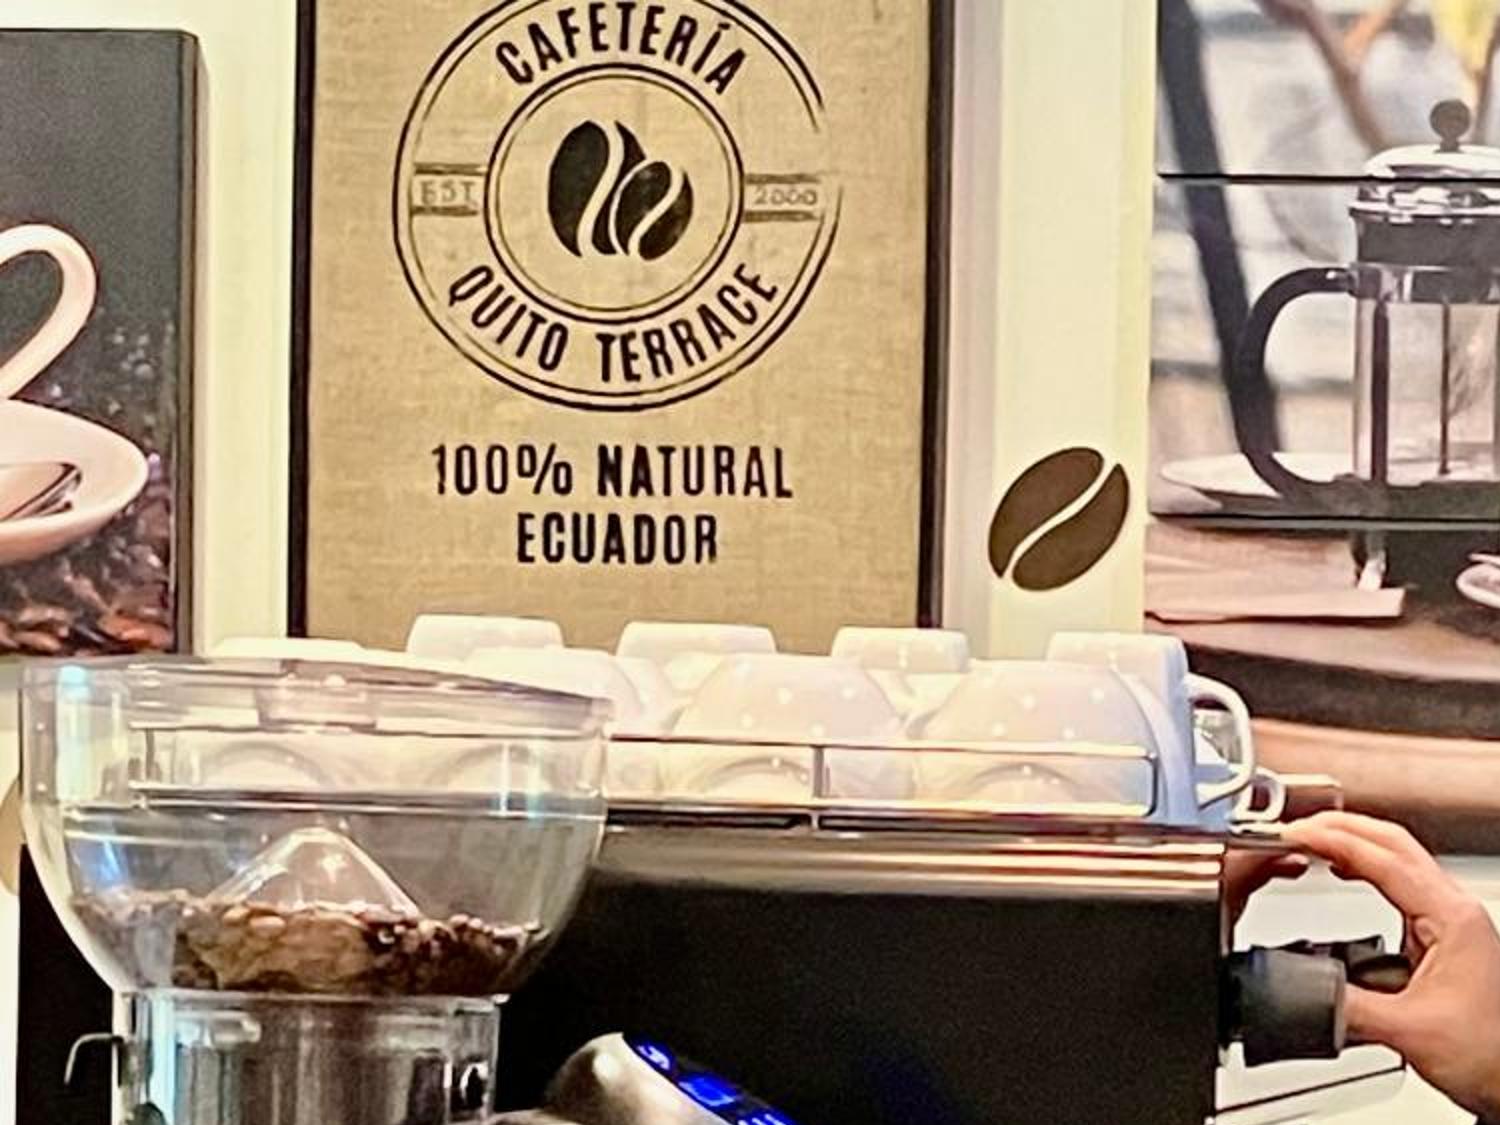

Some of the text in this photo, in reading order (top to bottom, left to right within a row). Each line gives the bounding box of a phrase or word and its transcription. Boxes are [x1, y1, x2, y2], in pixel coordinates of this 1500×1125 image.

[495, 2, 746, 95] CAFETERÍA
[448, 263, 778, 383] QUITO TERRACE
[431, 443, 793, 499] 100% NATURAL
[517, 511, 718, 565] ECUADOR
